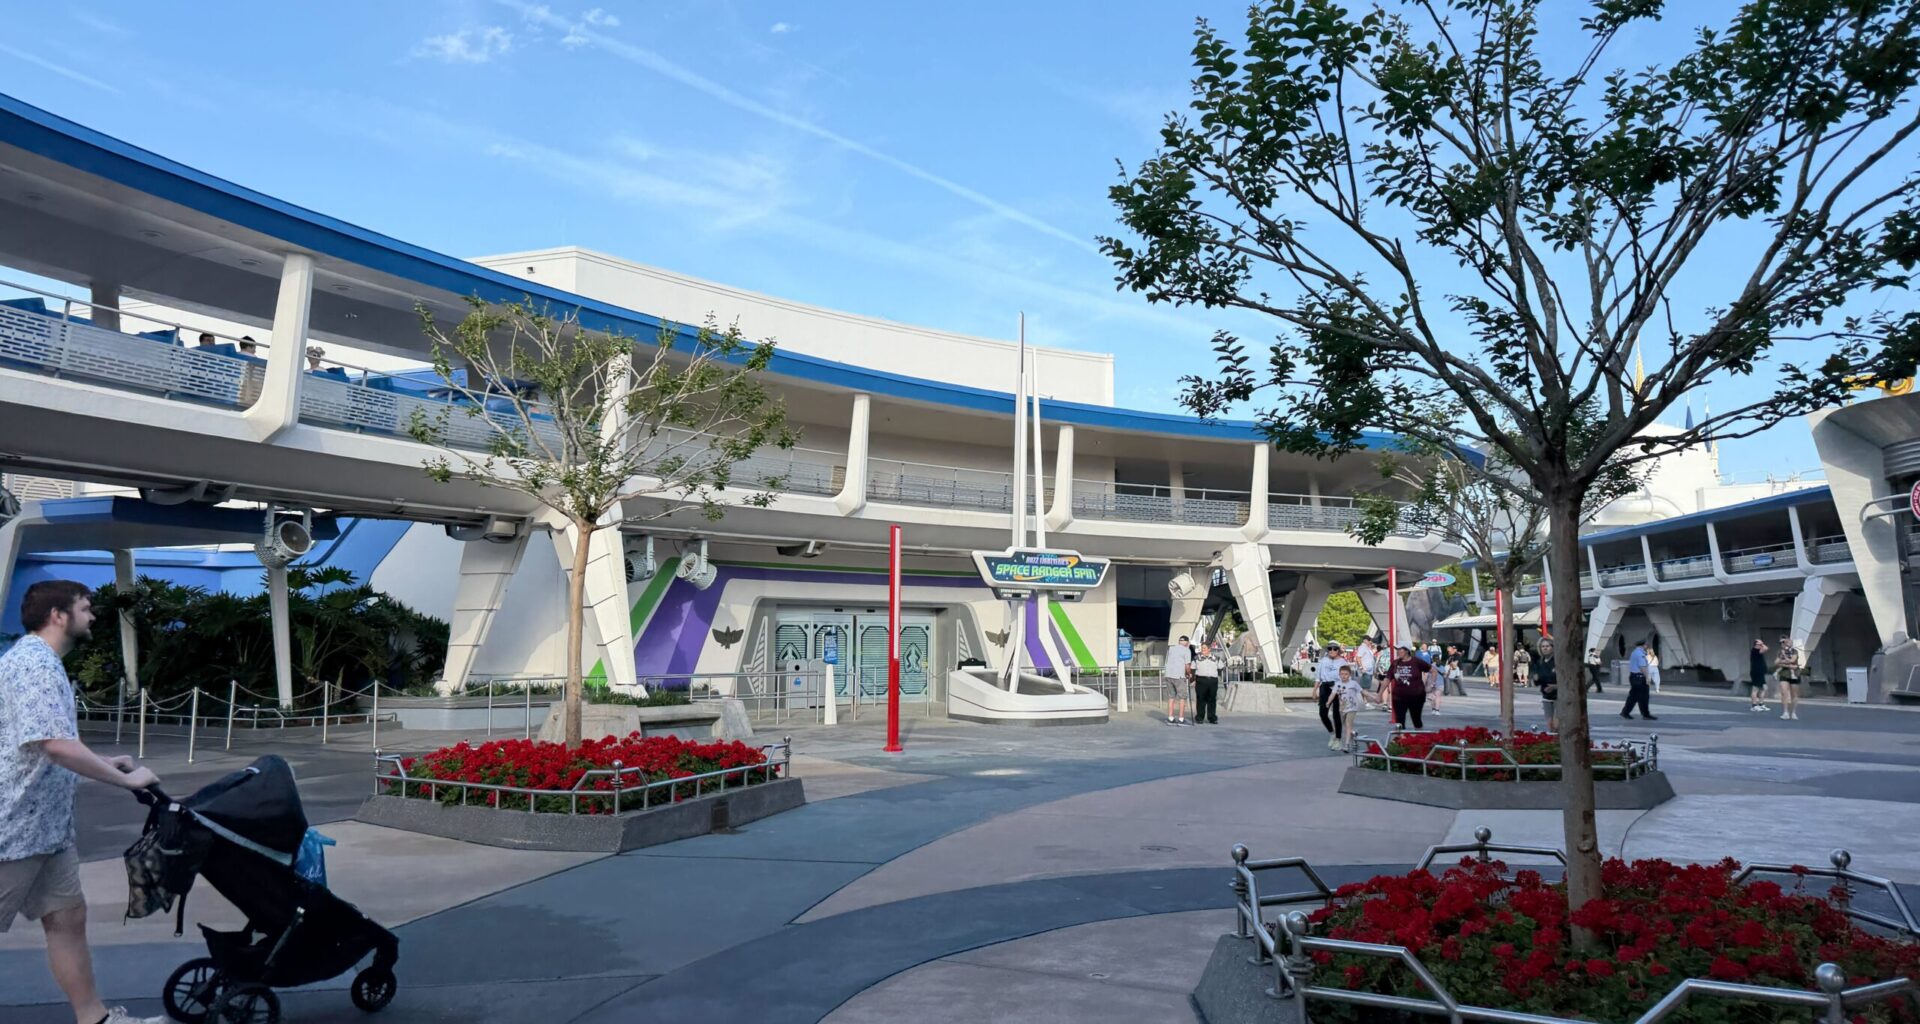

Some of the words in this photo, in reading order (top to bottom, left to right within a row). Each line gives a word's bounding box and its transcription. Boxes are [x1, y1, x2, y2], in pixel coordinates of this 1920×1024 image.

[995, 564, 1030, 575] SPACE
[1031, 566, 1073, 577] RANGER
[1073, 568, 1097, 579] SPIN
